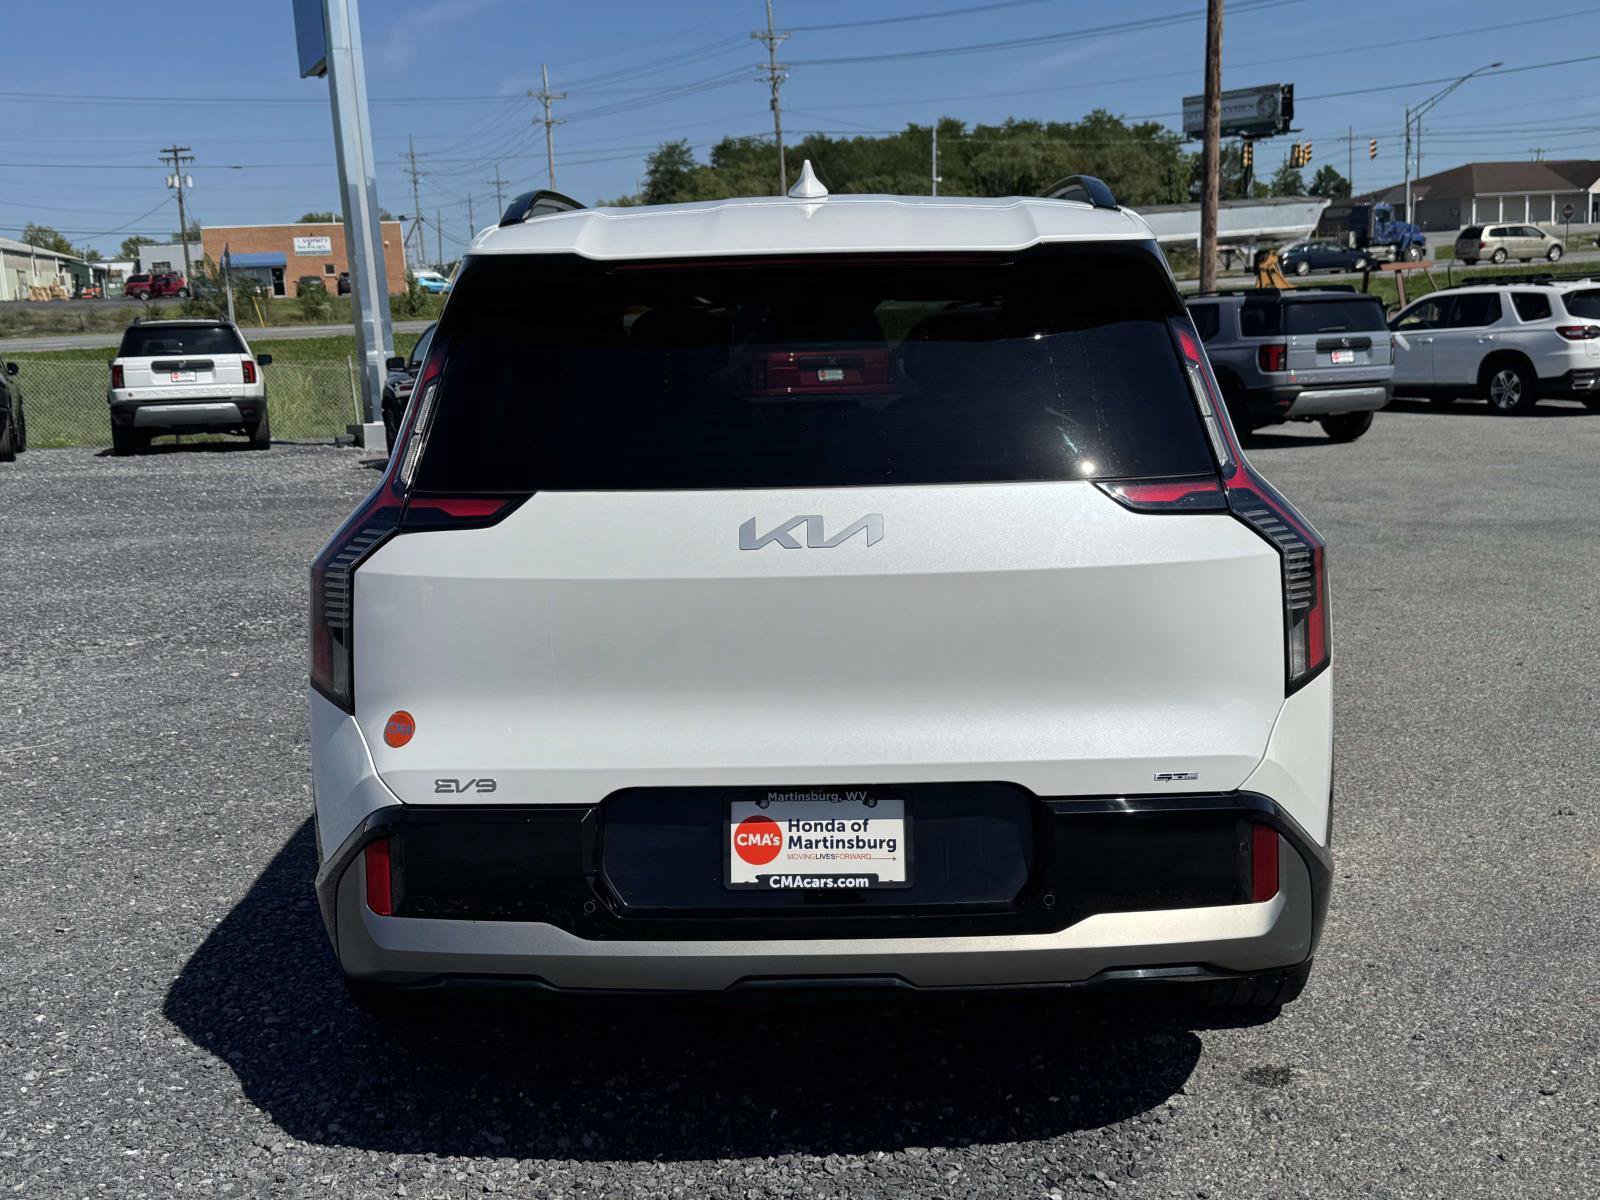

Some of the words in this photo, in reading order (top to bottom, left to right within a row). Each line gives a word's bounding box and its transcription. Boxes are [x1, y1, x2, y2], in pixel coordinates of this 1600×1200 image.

[739, 514, 884, 550] KIA
[435, 778, 497, 793] EV9
[767, 791, 842, 803] Martinsburg,
[845, 791, 867, 801] WV
[788, 818, 846, 833] Honda
[850, 818, 869, 833] of
[736, 833, 781, 846] CMA's
[788, 836, 897, 853] Martinsburg
[769, 875, 869, 888] CMAcars.com
